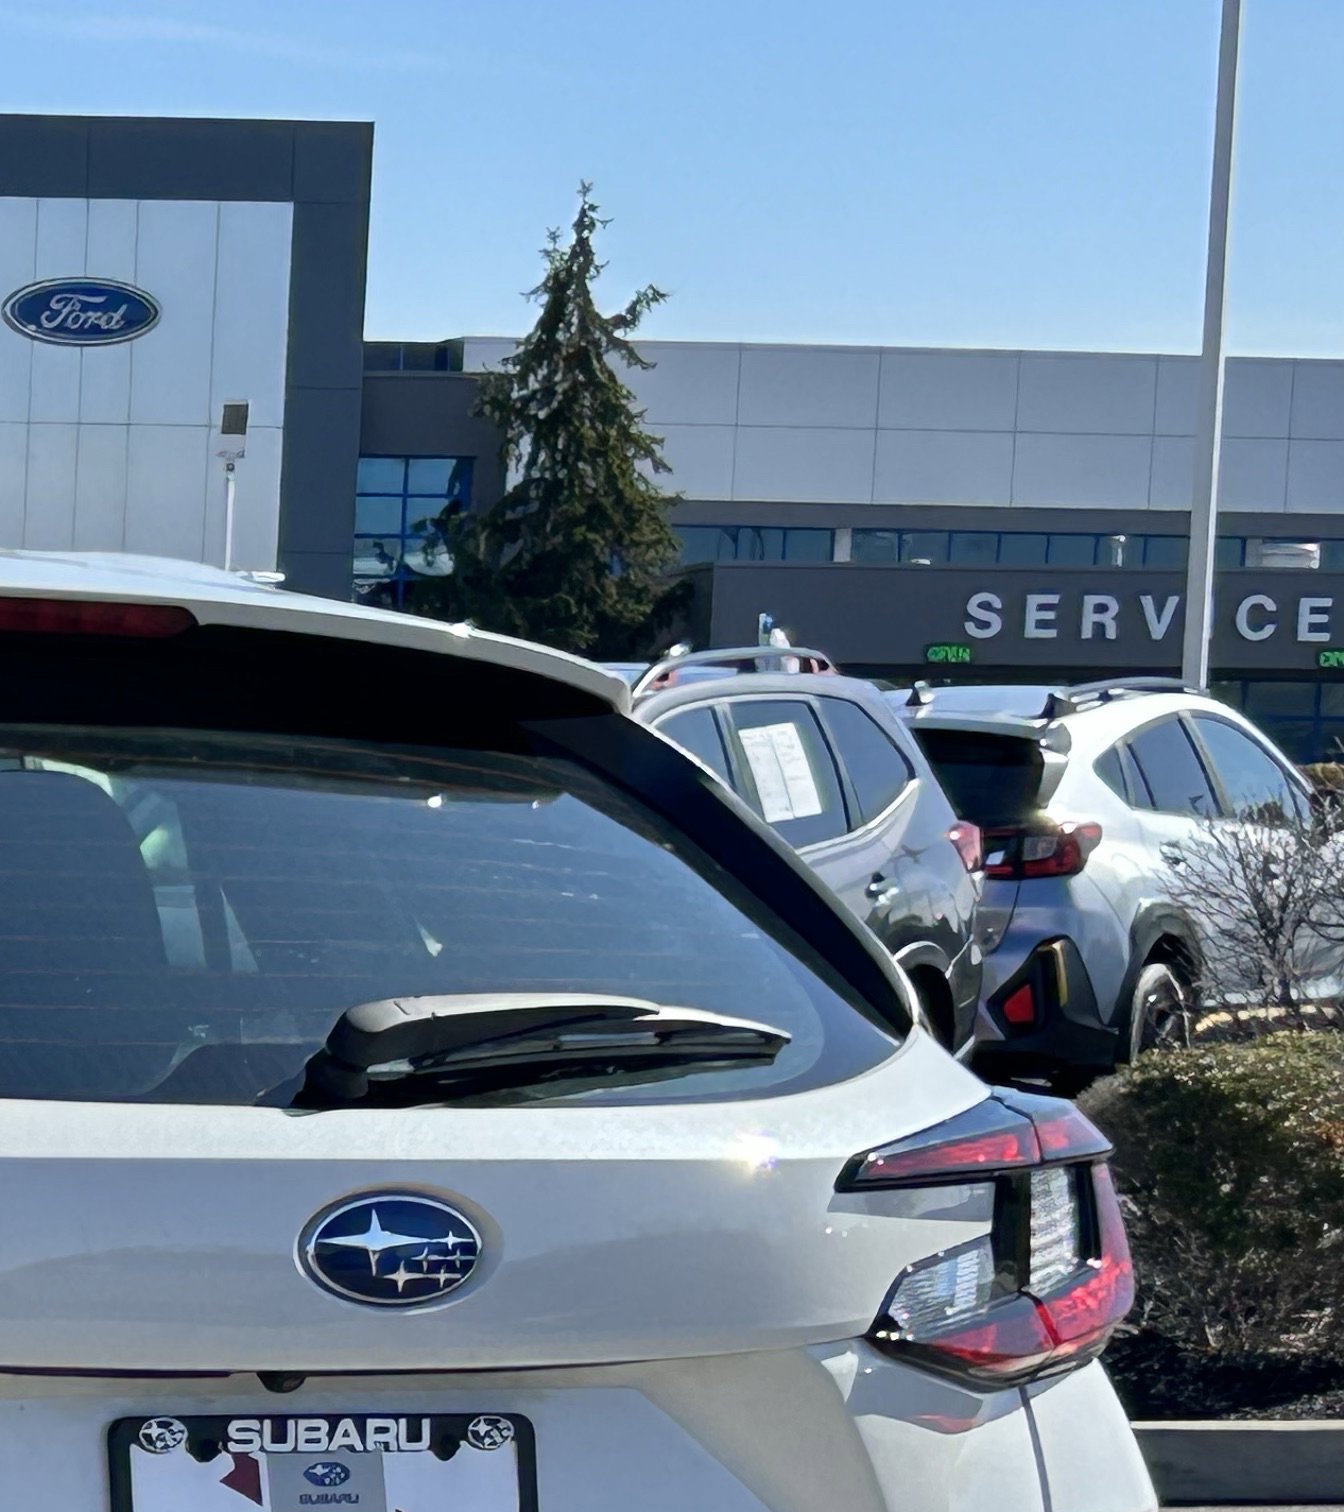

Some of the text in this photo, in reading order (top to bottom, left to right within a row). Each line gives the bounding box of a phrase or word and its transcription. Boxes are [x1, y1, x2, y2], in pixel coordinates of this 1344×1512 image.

[40, 293, 128, 329] Ford
[963, 592, 1333, 642] SERVCE
[226, 1417, 431, 1453] SUBARU
